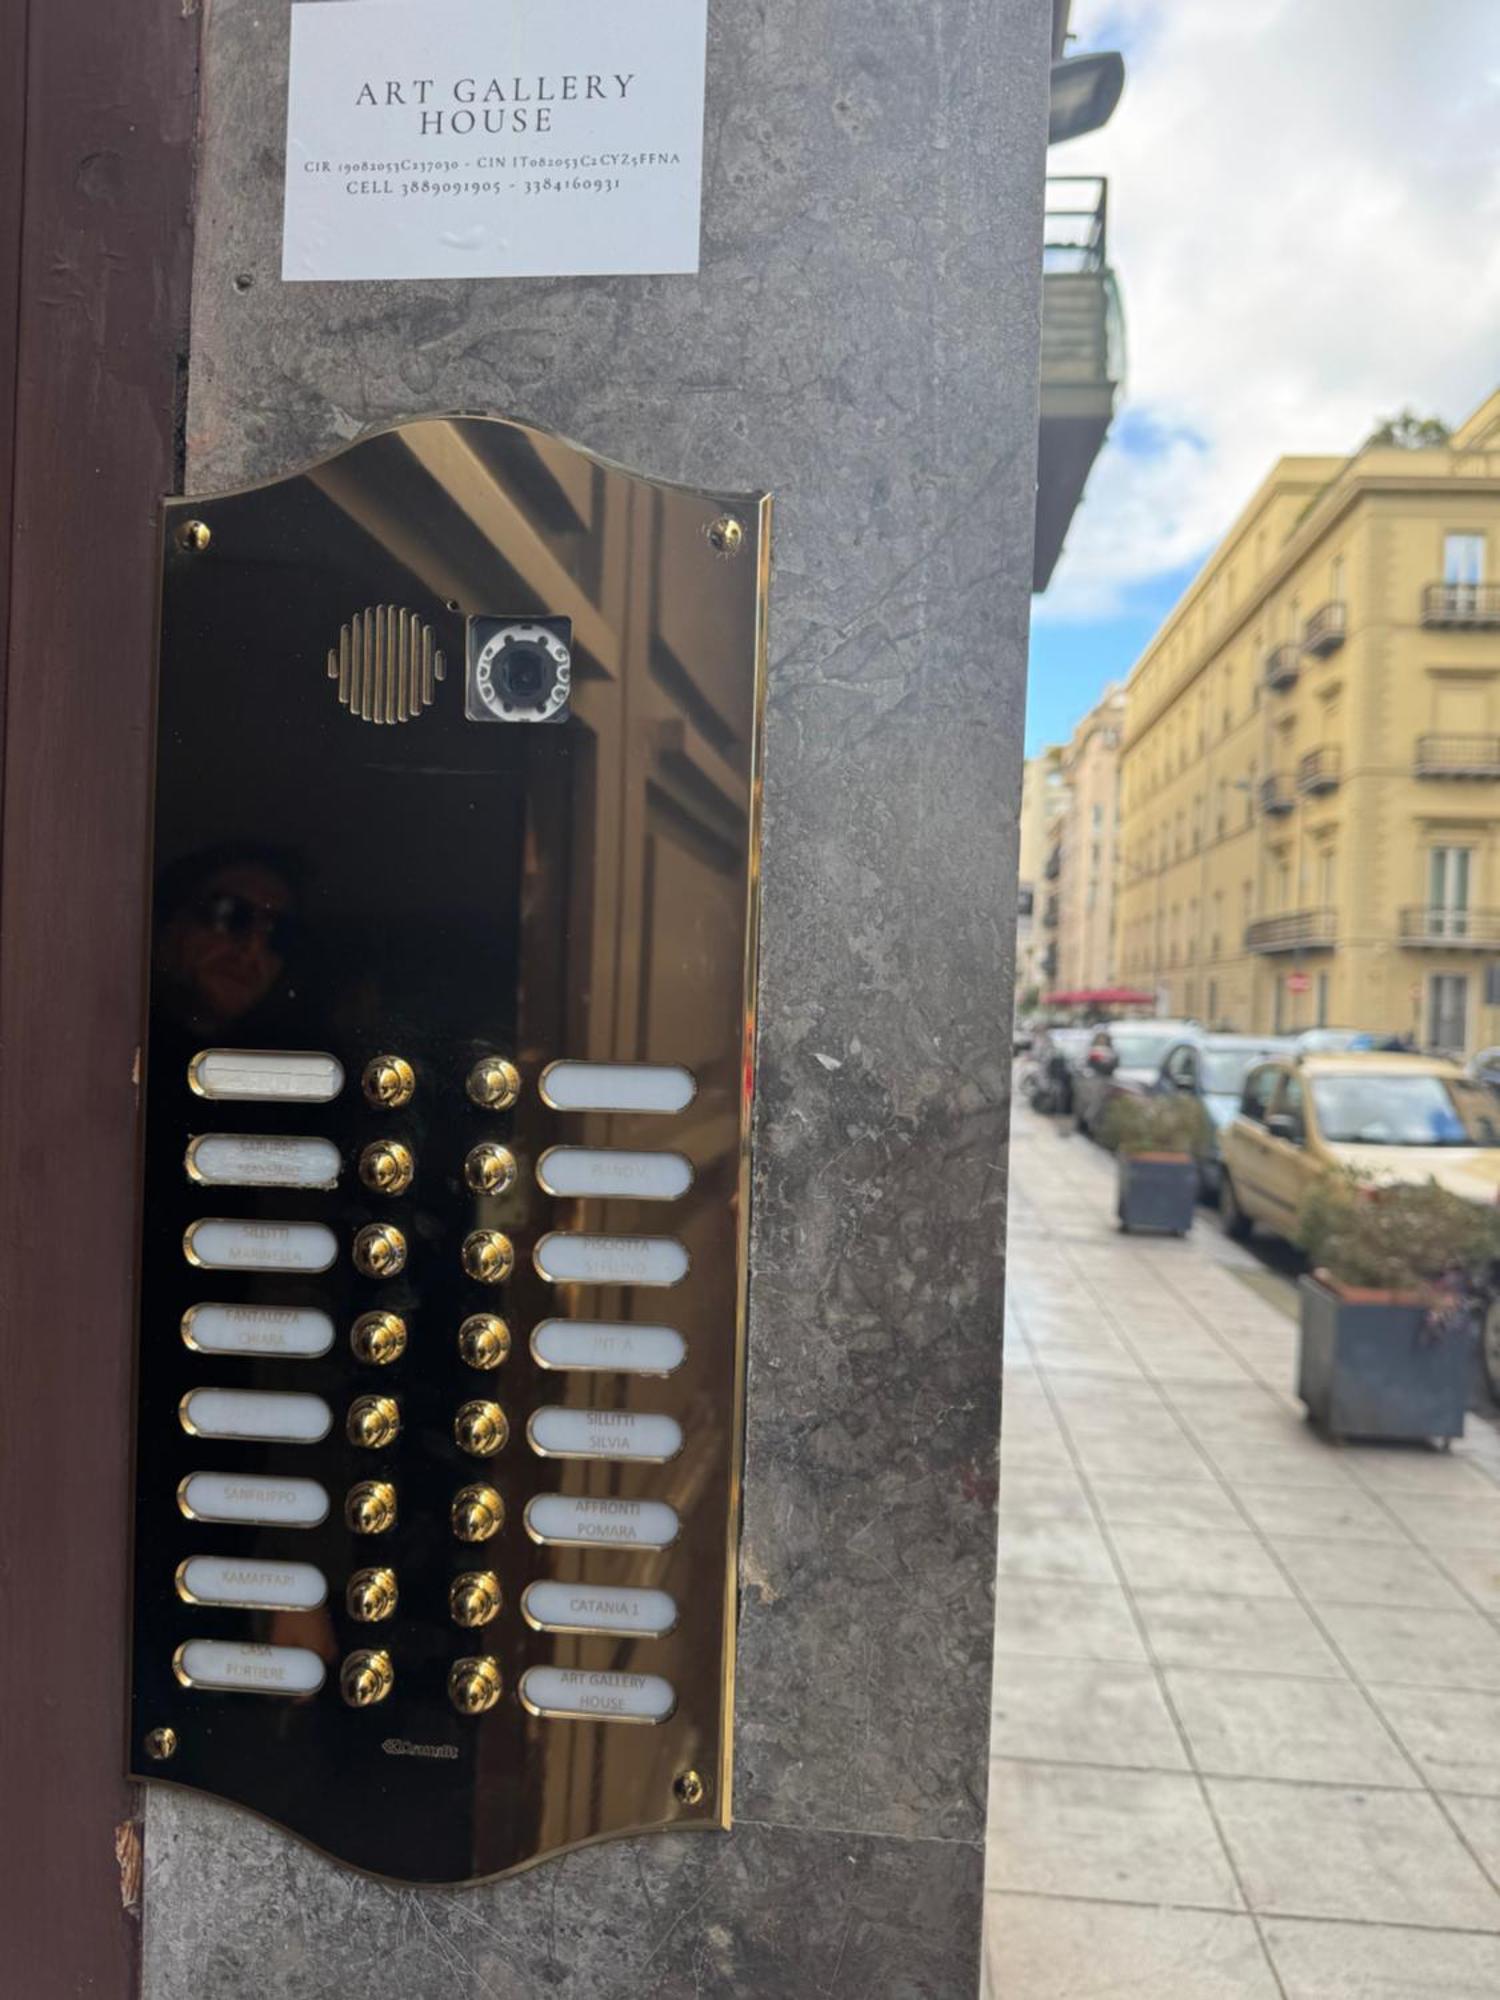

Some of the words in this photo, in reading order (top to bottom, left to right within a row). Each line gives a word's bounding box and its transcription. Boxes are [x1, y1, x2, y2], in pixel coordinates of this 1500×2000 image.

[356, 80, 434, 105] ART
[454, 74, 635, 103] GALLERY
[420, 108, 552, 135] HOUSE
[304, 160, 331, 172] CIR
[477, 156, 506, 168] CIN
[346, 180, 394, 195] CELL
[401, 180, 501, 198] 3889091905
[524, 177, 620, 194] 3384160931
[586, 1413, 635, 1427] SILLITTI
[590, 1436, 631, 1449] SILVIA
[575, 1501, 641, 1516] AFFRONTI
[577, 1523, 637, 1538] POMARA
[570, 1600, 628, 1616] CATANIA
[632, 1603, 639, 1616] 1
[561, 1673, 586, 1685] ART
[589, 1674, 646, 1689] GALLERY
[580, 1695, 625, 1710] HOUSE
